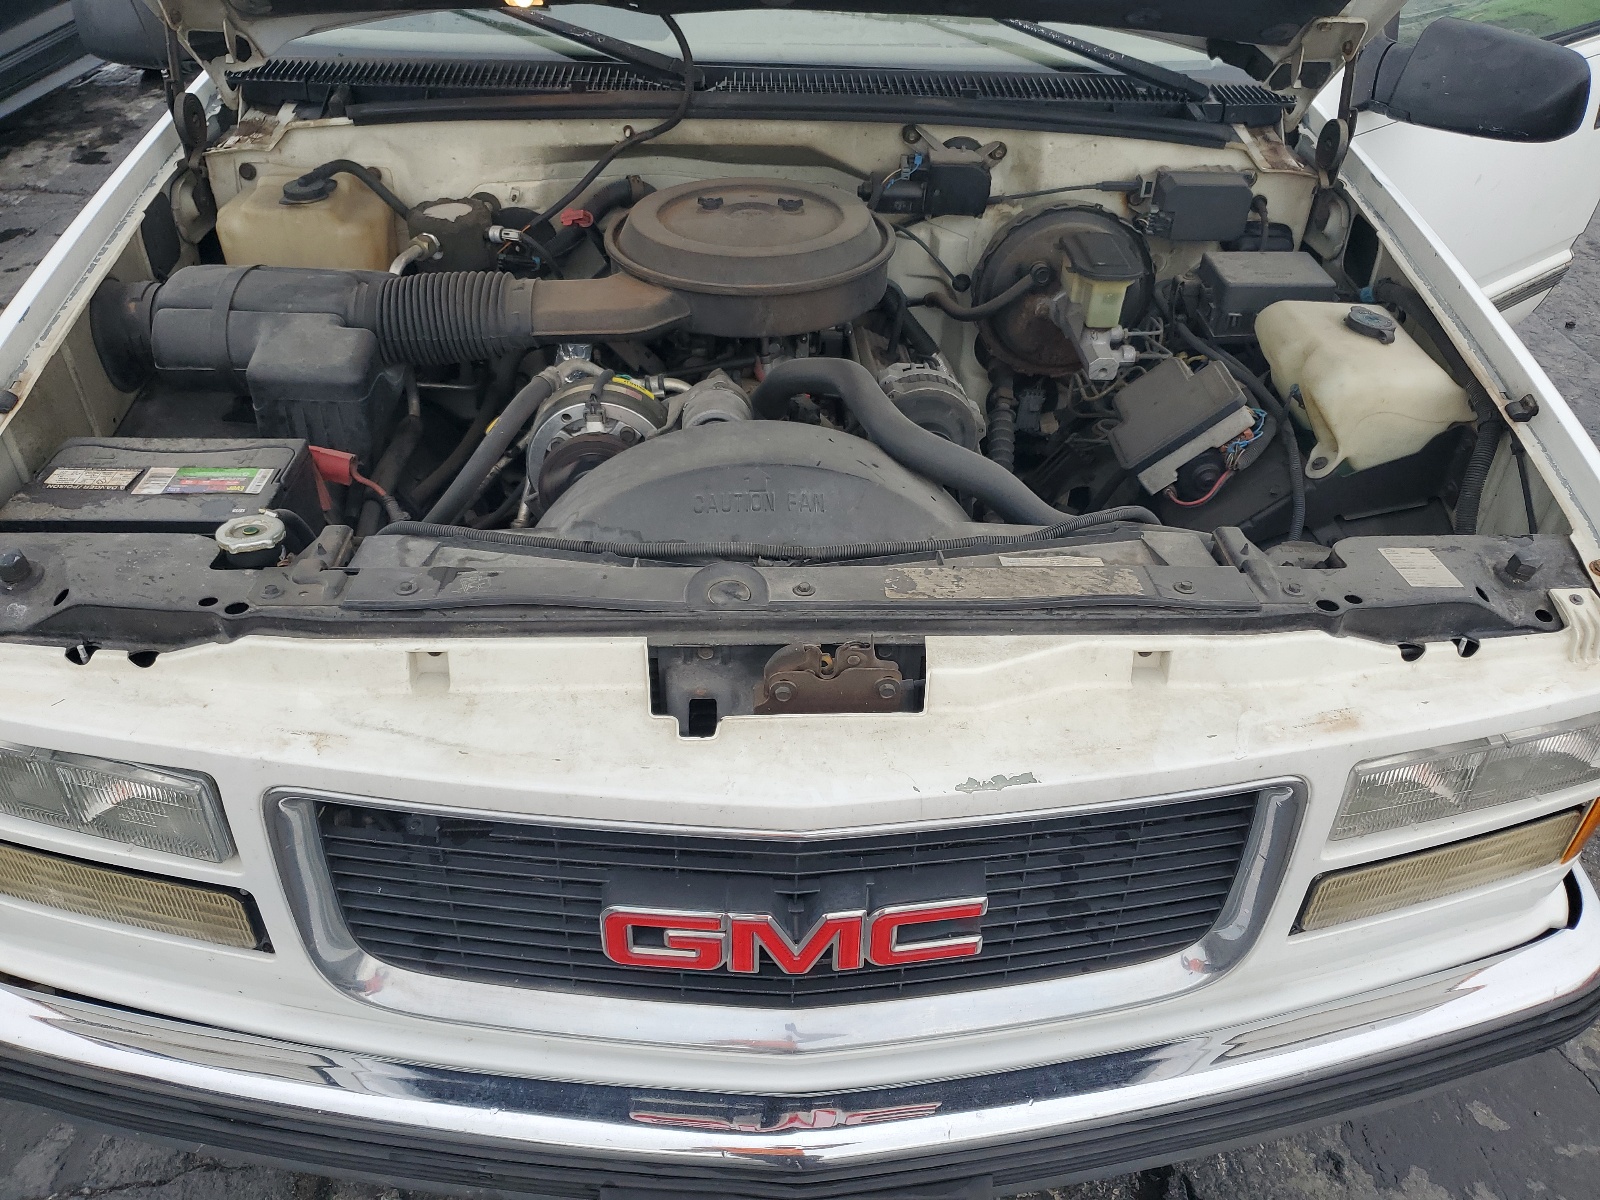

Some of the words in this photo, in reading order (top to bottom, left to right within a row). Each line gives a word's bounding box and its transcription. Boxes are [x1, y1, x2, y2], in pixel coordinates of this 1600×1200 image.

[693, 491, 776, 514] CAUTION
[787, 492, 825, 513] FAN
[600, 896, 988, 974] GMC
